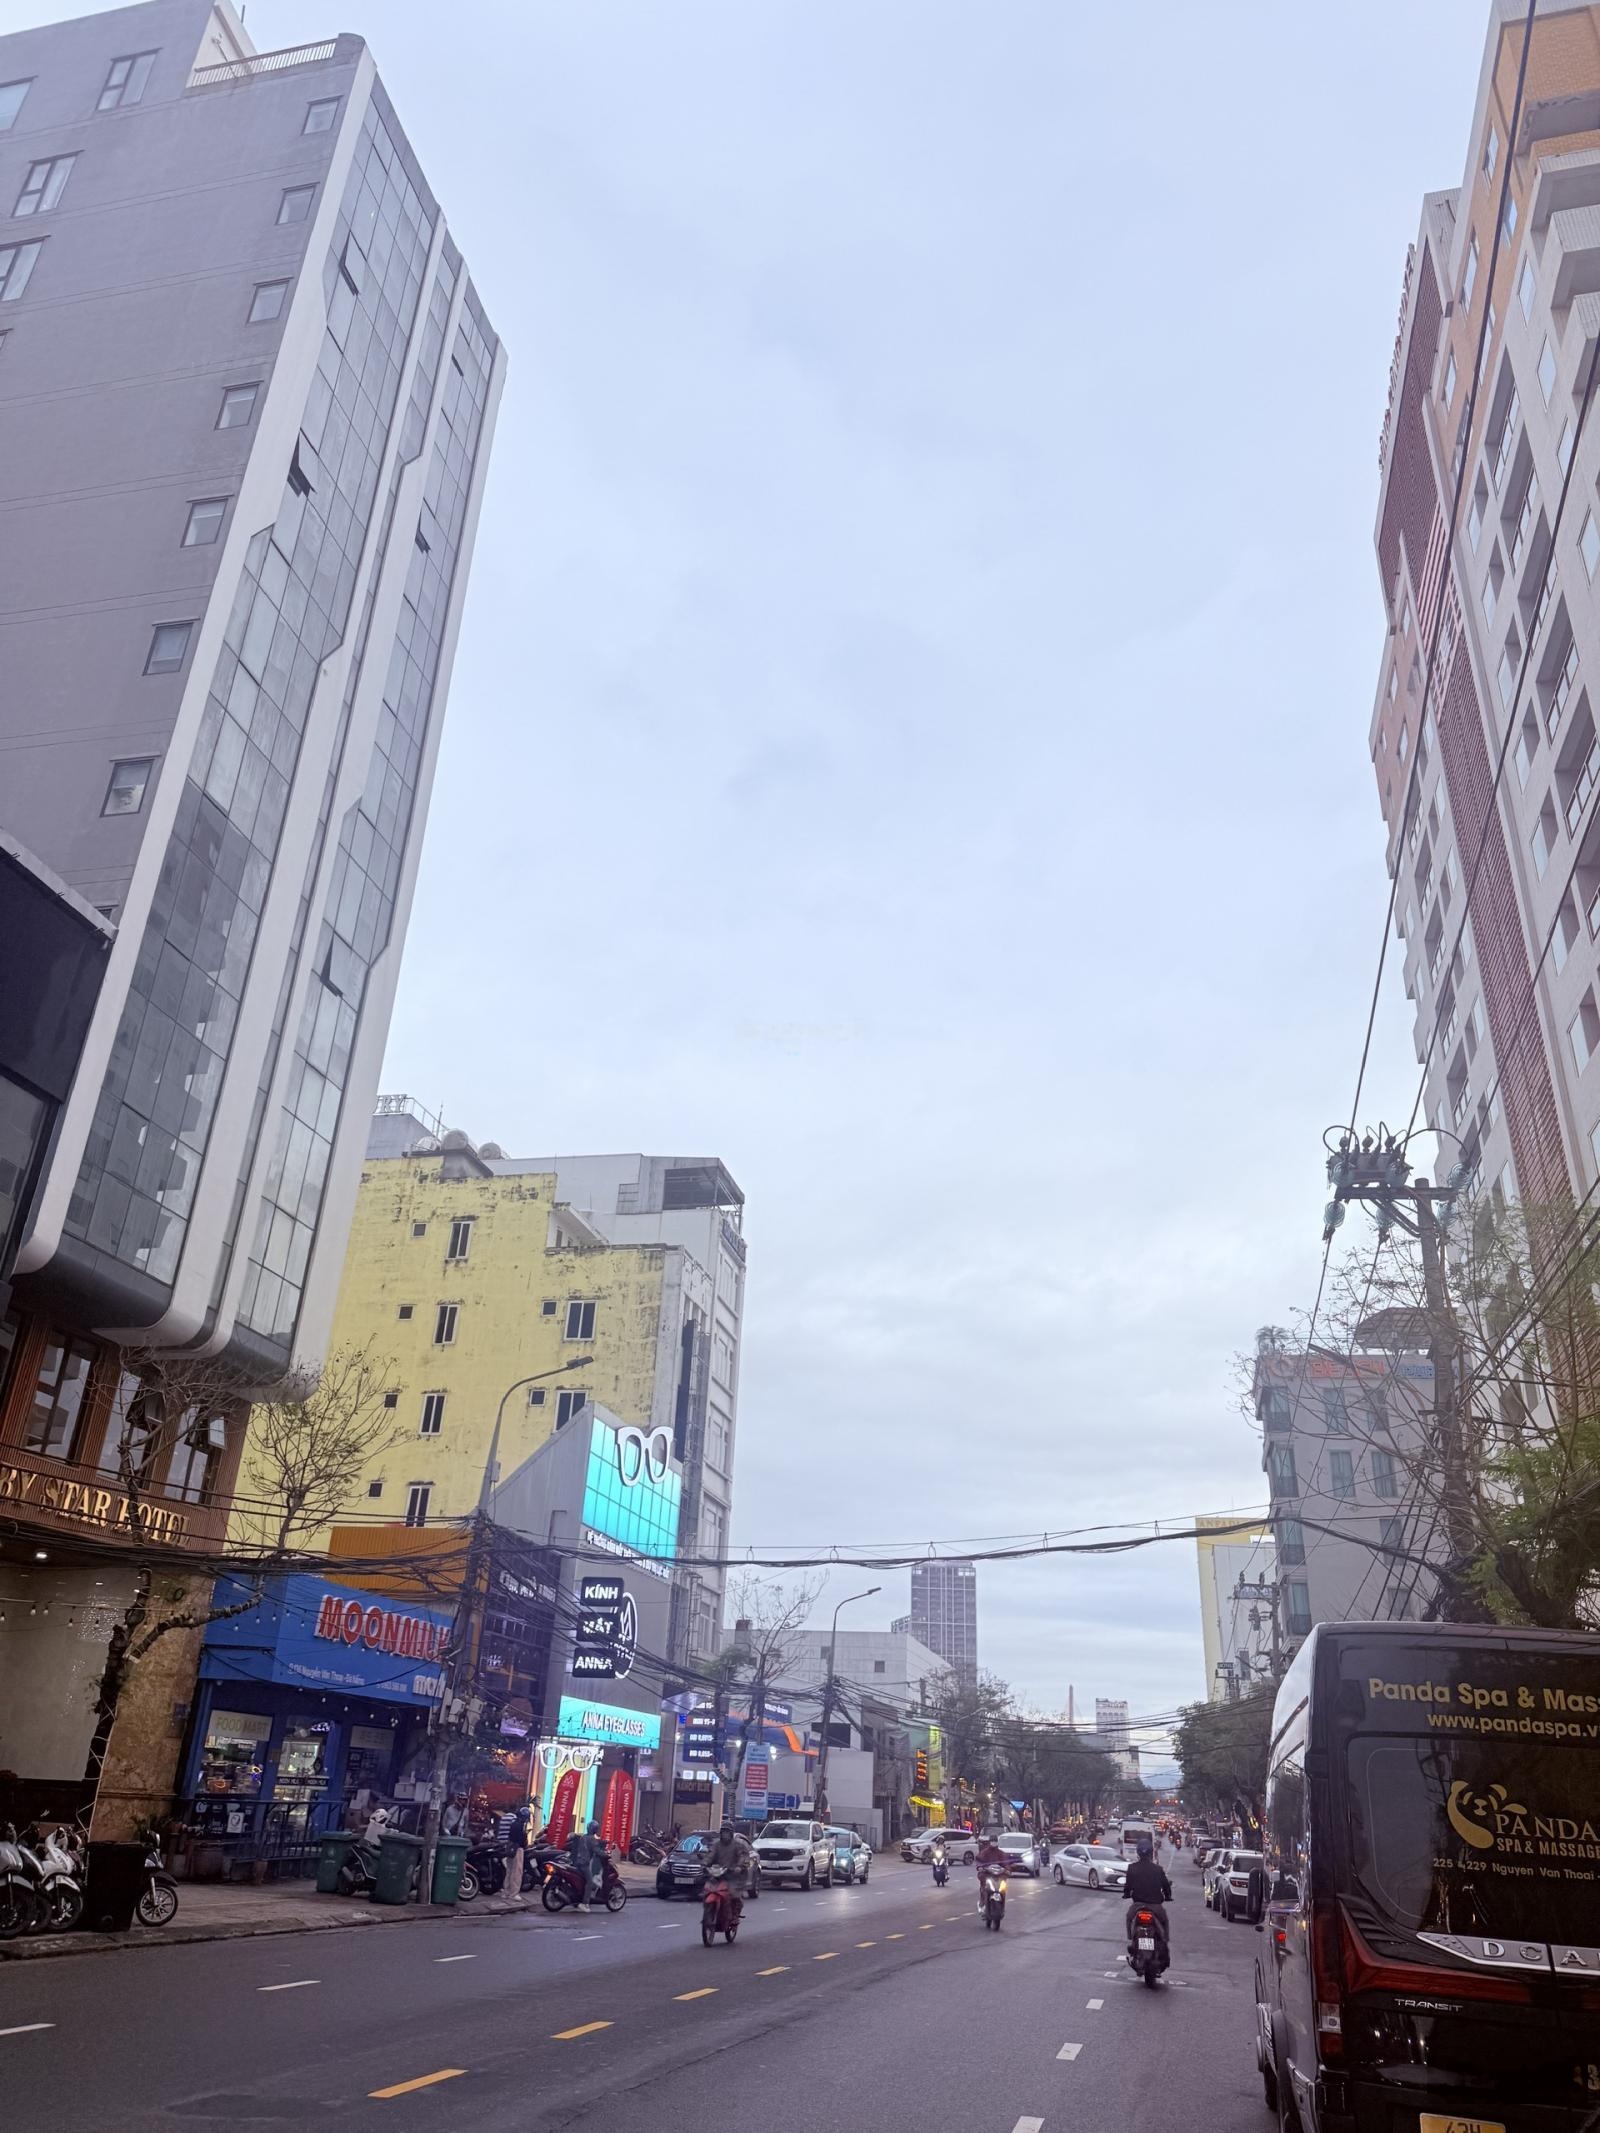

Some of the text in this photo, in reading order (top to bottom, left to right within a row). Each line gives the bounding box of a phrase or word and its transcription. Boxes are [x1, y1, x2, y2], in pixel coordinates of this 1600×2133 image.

[39, 1477, 112, 1529] STAR
[584, 1583, 619, 1600] KÍNH
[574, 1655, 613, 1670] ANNA
[1368, 1677, 1600, 1713] Panda Spa & Mas
[216, 1715, 242, 1731] FOOD
[582, 1710, 646, 1737] ANNA EYEGLASSES
[560, 1790, 570, 1813] ANNA
[1494, 1813, 1600, 1842] PANDA
[1497, 1837, 1523, 1853] SPA
[1524, 1840, 1534, 1854] &
[1433, 1857, 1454, 1868] 225
[1466, 1860, 1487, 1871] 229
[1492, 1862, 1534, 1876] Nguyen
[1539, 1867, 1561, 1878] Van
[1563, 1868, 1595, 1880] Thoai
[1482, 1939, 1600, 1967] DCA
[1394, 1997, 1464, 2012] TRANSIT
